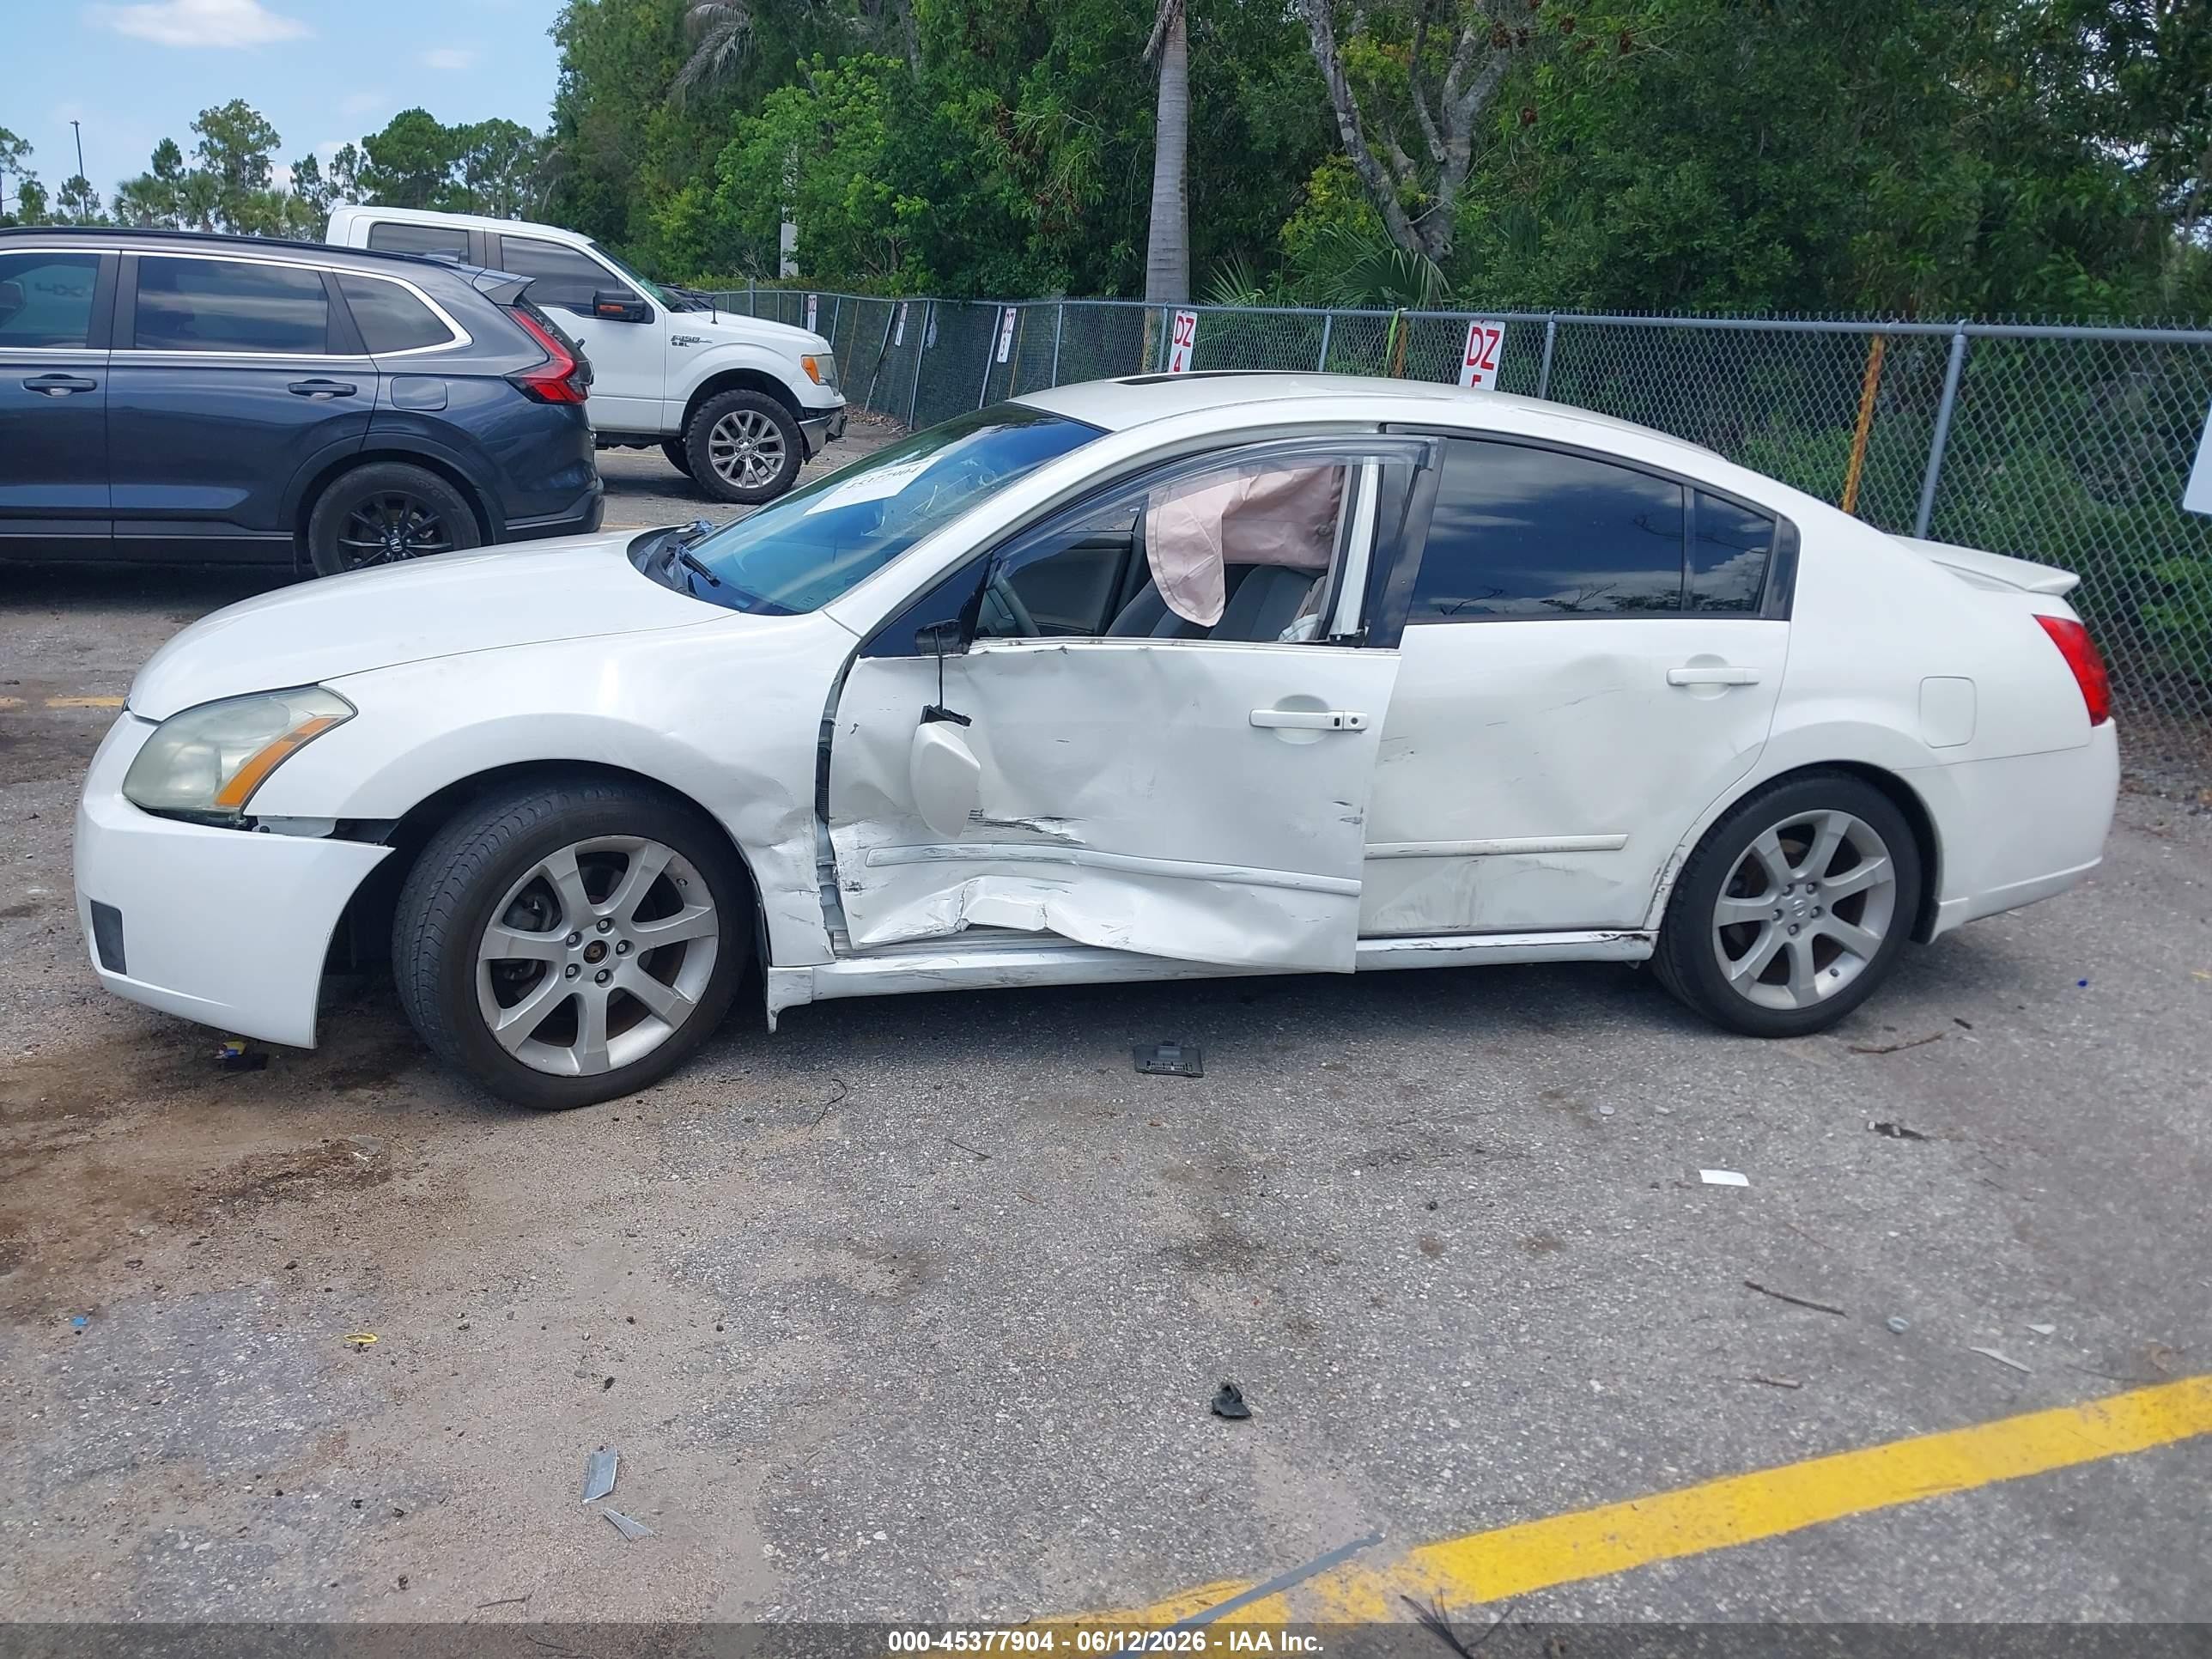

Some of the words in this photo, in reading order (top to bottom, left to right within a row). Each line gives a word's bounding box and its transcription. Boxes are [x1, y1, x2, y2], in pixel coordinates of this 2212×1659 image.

[1003, 312, 1014, 334] DZ
[1174, 315, 1194, 348] DZ
[1466, 326, 1500, 371] DZ
